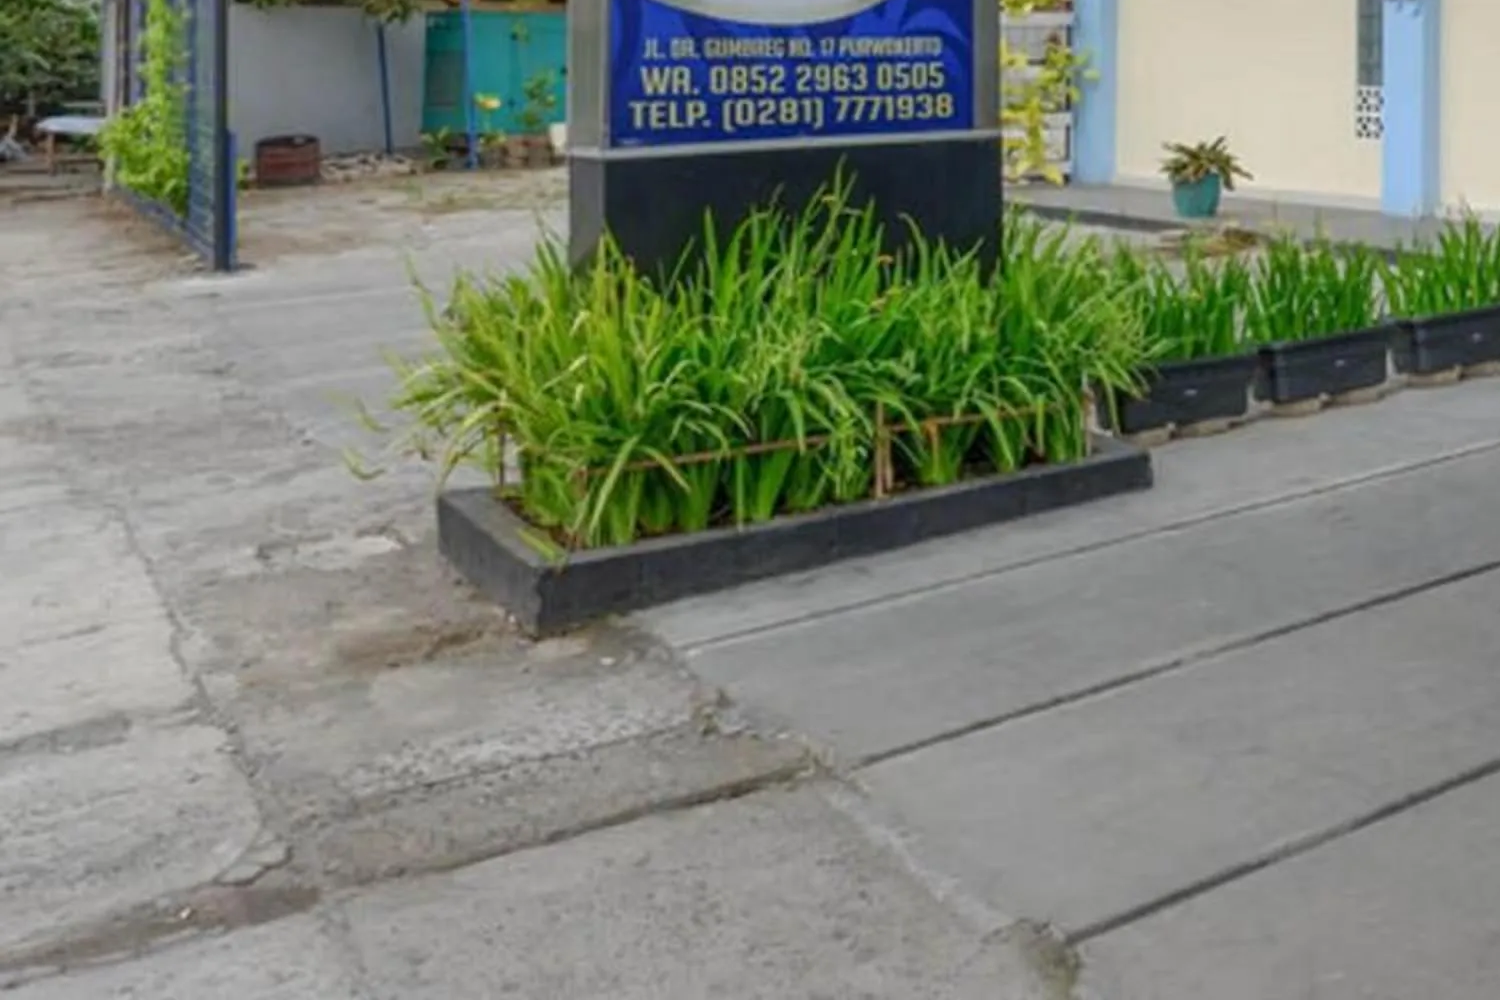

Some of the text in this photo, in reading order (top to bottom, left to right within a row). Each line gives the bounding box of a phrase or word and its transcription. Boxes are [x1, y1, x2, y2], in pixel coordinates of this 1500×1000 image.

[640, 61, 945, 96] WA. 0852 2963 0505
[628, 92, 954, 133] TELP. (0281) 7771938
